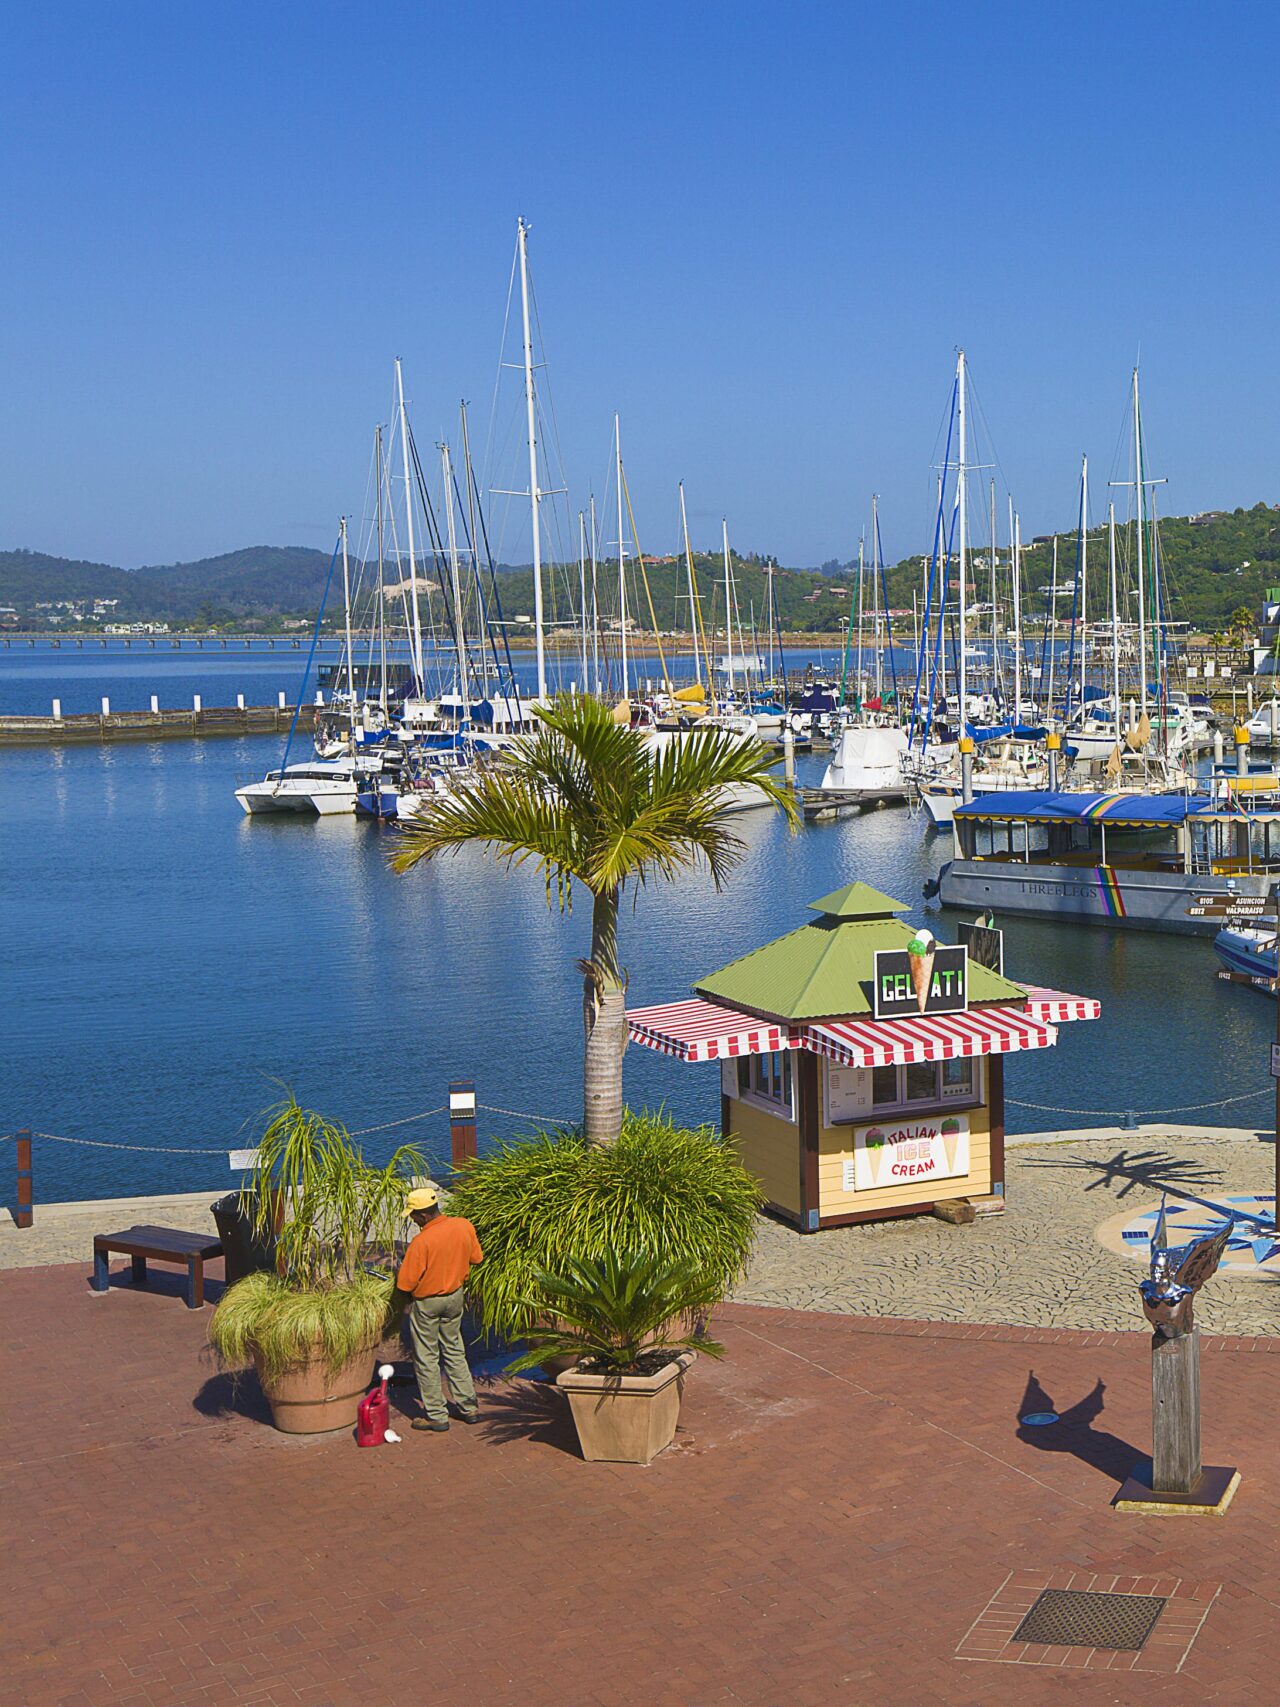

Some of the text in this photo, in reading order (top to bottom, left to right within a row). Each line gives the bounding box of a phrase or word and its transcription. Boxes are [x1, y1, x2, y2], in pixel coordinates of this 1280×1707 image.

[1235, 897, 1266, 905] ASUNCION
[1225, 906, 1264, 915] VALPARAISO
[882, 970, 963, 1002] GELATI
[887, 1126, 937, 1146] ITALIAN
[897, 1141, 931, 1161] ICE
[891, 1159, 936, 1176] CREAM
